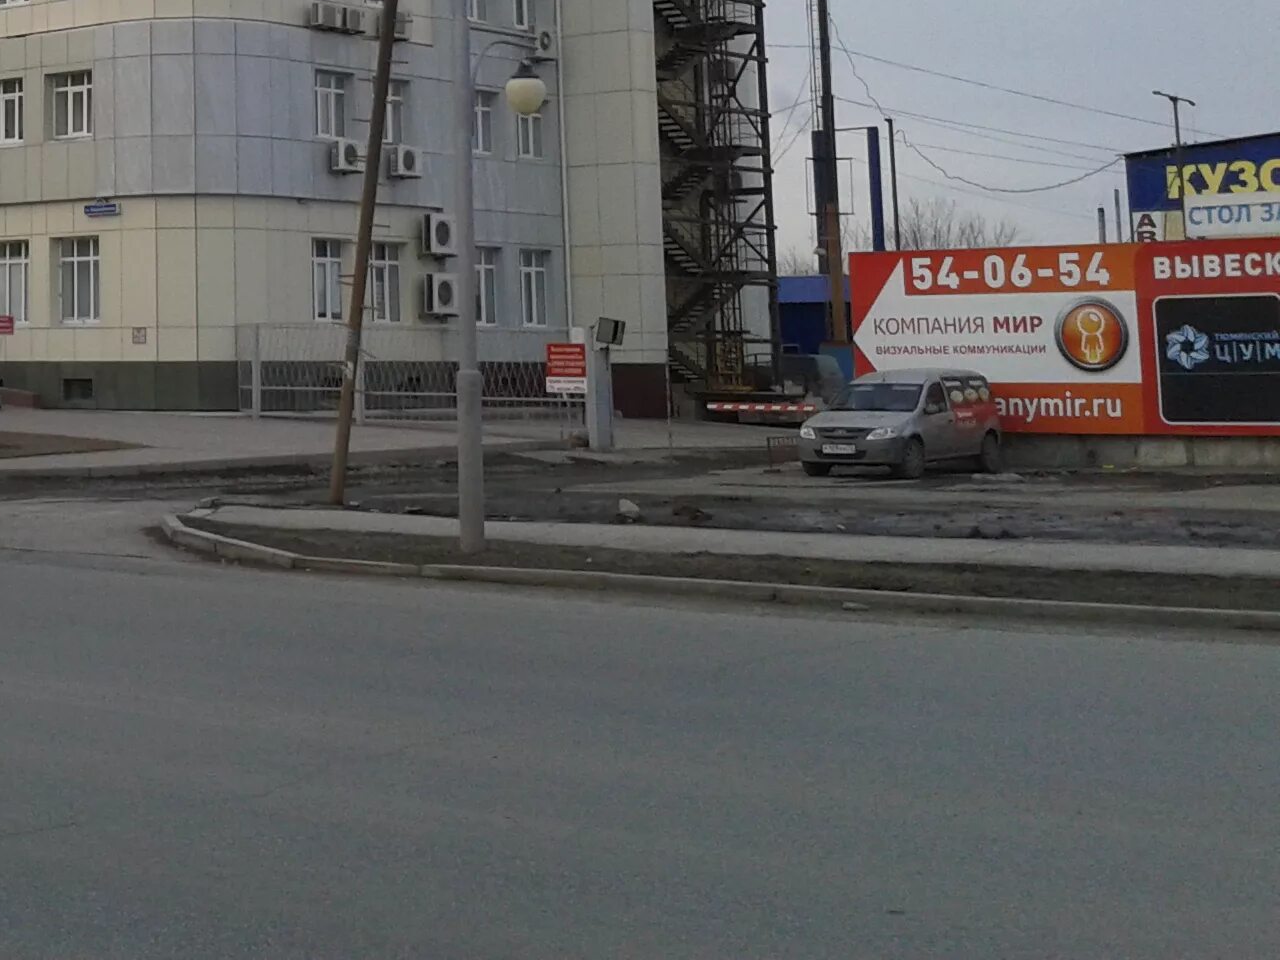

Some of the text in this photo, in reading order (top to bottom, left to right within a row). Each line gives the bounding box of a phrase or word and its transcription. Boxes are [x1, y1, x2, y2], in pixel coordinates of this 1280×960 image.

[1189, 204, 1251, 225] СТОЛ
[911, 252, 1111, 290] 54-06-54
[1153, 252, 1280, 279] ВЫВЕСК
[873, 315, 1043, 336] КОМПАНИЯ МИР
[875, 344, 1047, 356] ВИЗУАЛЬНЫЕ КОММУНИКАЦИИ
